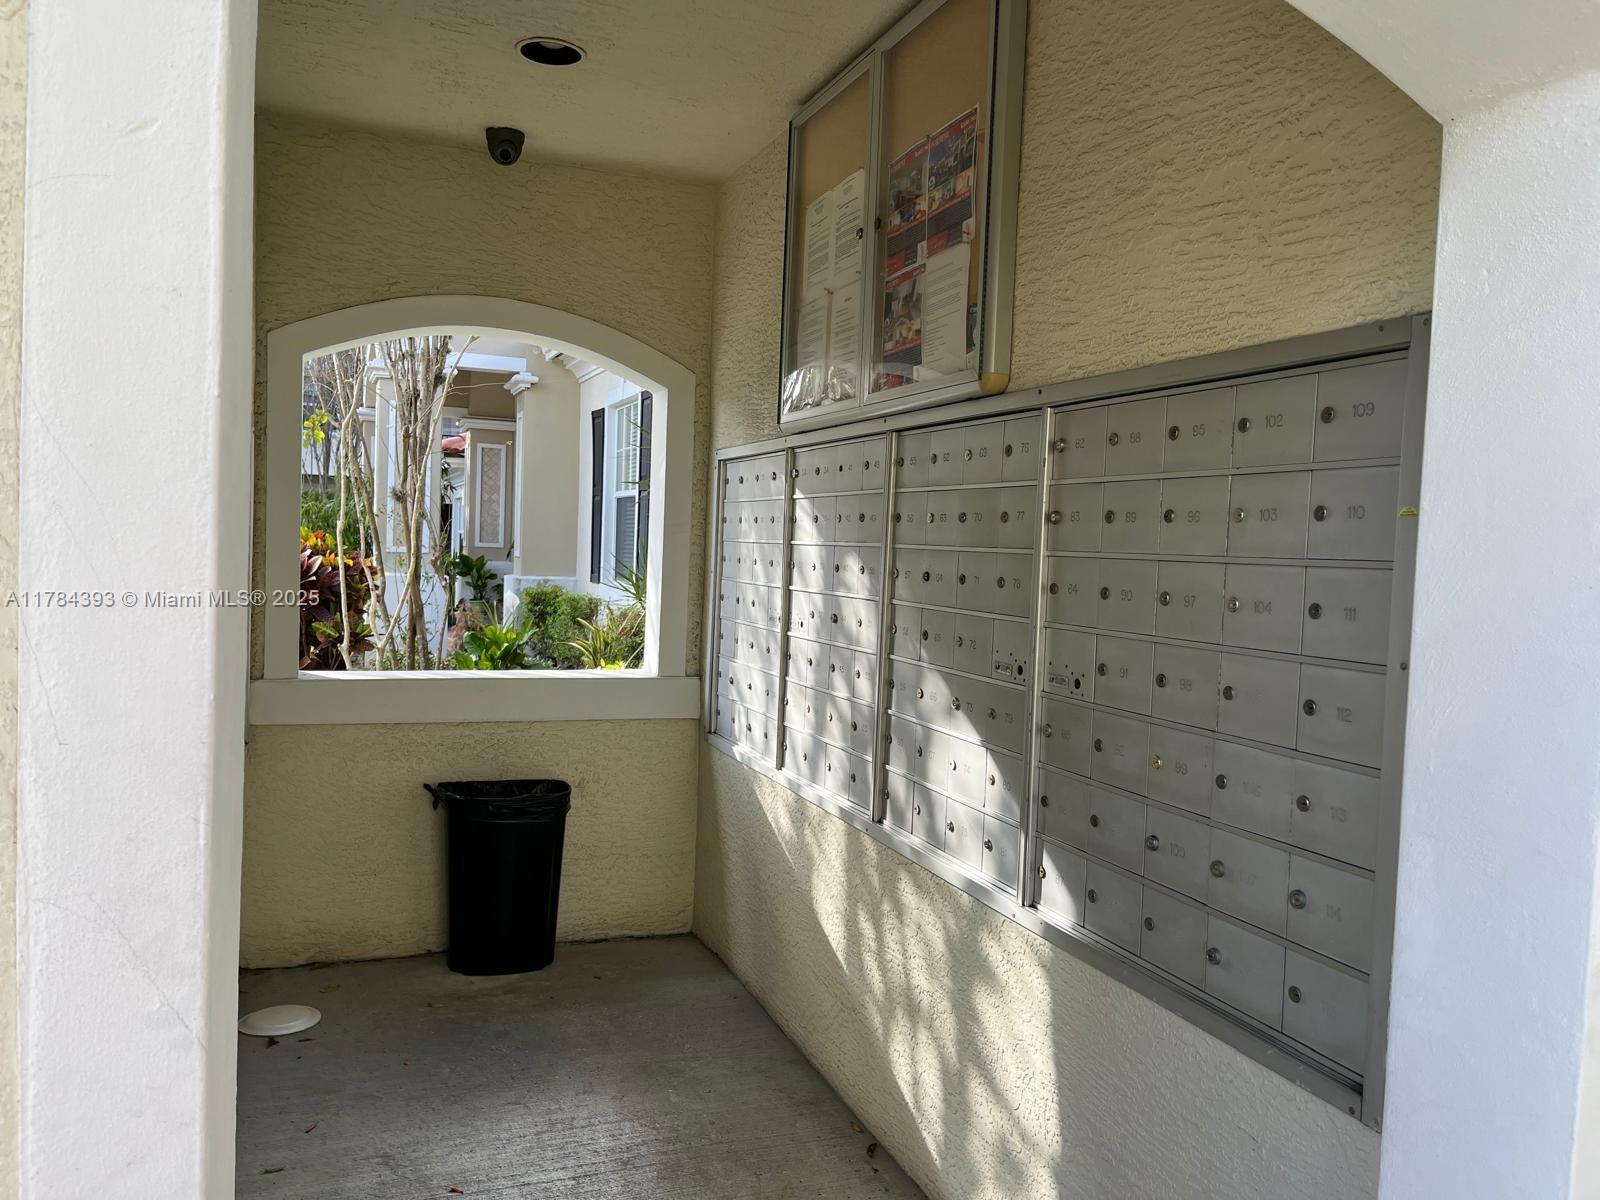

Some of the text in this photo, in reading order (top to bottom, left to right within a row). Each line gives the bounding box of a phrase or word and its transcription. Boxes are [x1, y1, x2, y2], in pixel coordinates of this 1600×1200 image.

[1352, 401, 1375, 418] 109
[1265, 413, 1284, 429] 102
[1192, 423, 1206, 437] 95
[974, 512, 983, 522] 70
[1017, 511, 1025, 520] 77
[1070, 511, 1080, 522] 83
[1125, 511, 1137, 523] 89
[1259, 507, 1278, 522] 103
[1347, 505, 1366, 520] 110
[974, 576, 980, 585] 71
[1183, 595, 1196, 608] 97
[1254, 600, 1272, 615] 104
[1344, 607, 1357, 622] 111
[1336, 706, 1353, 723] 112
